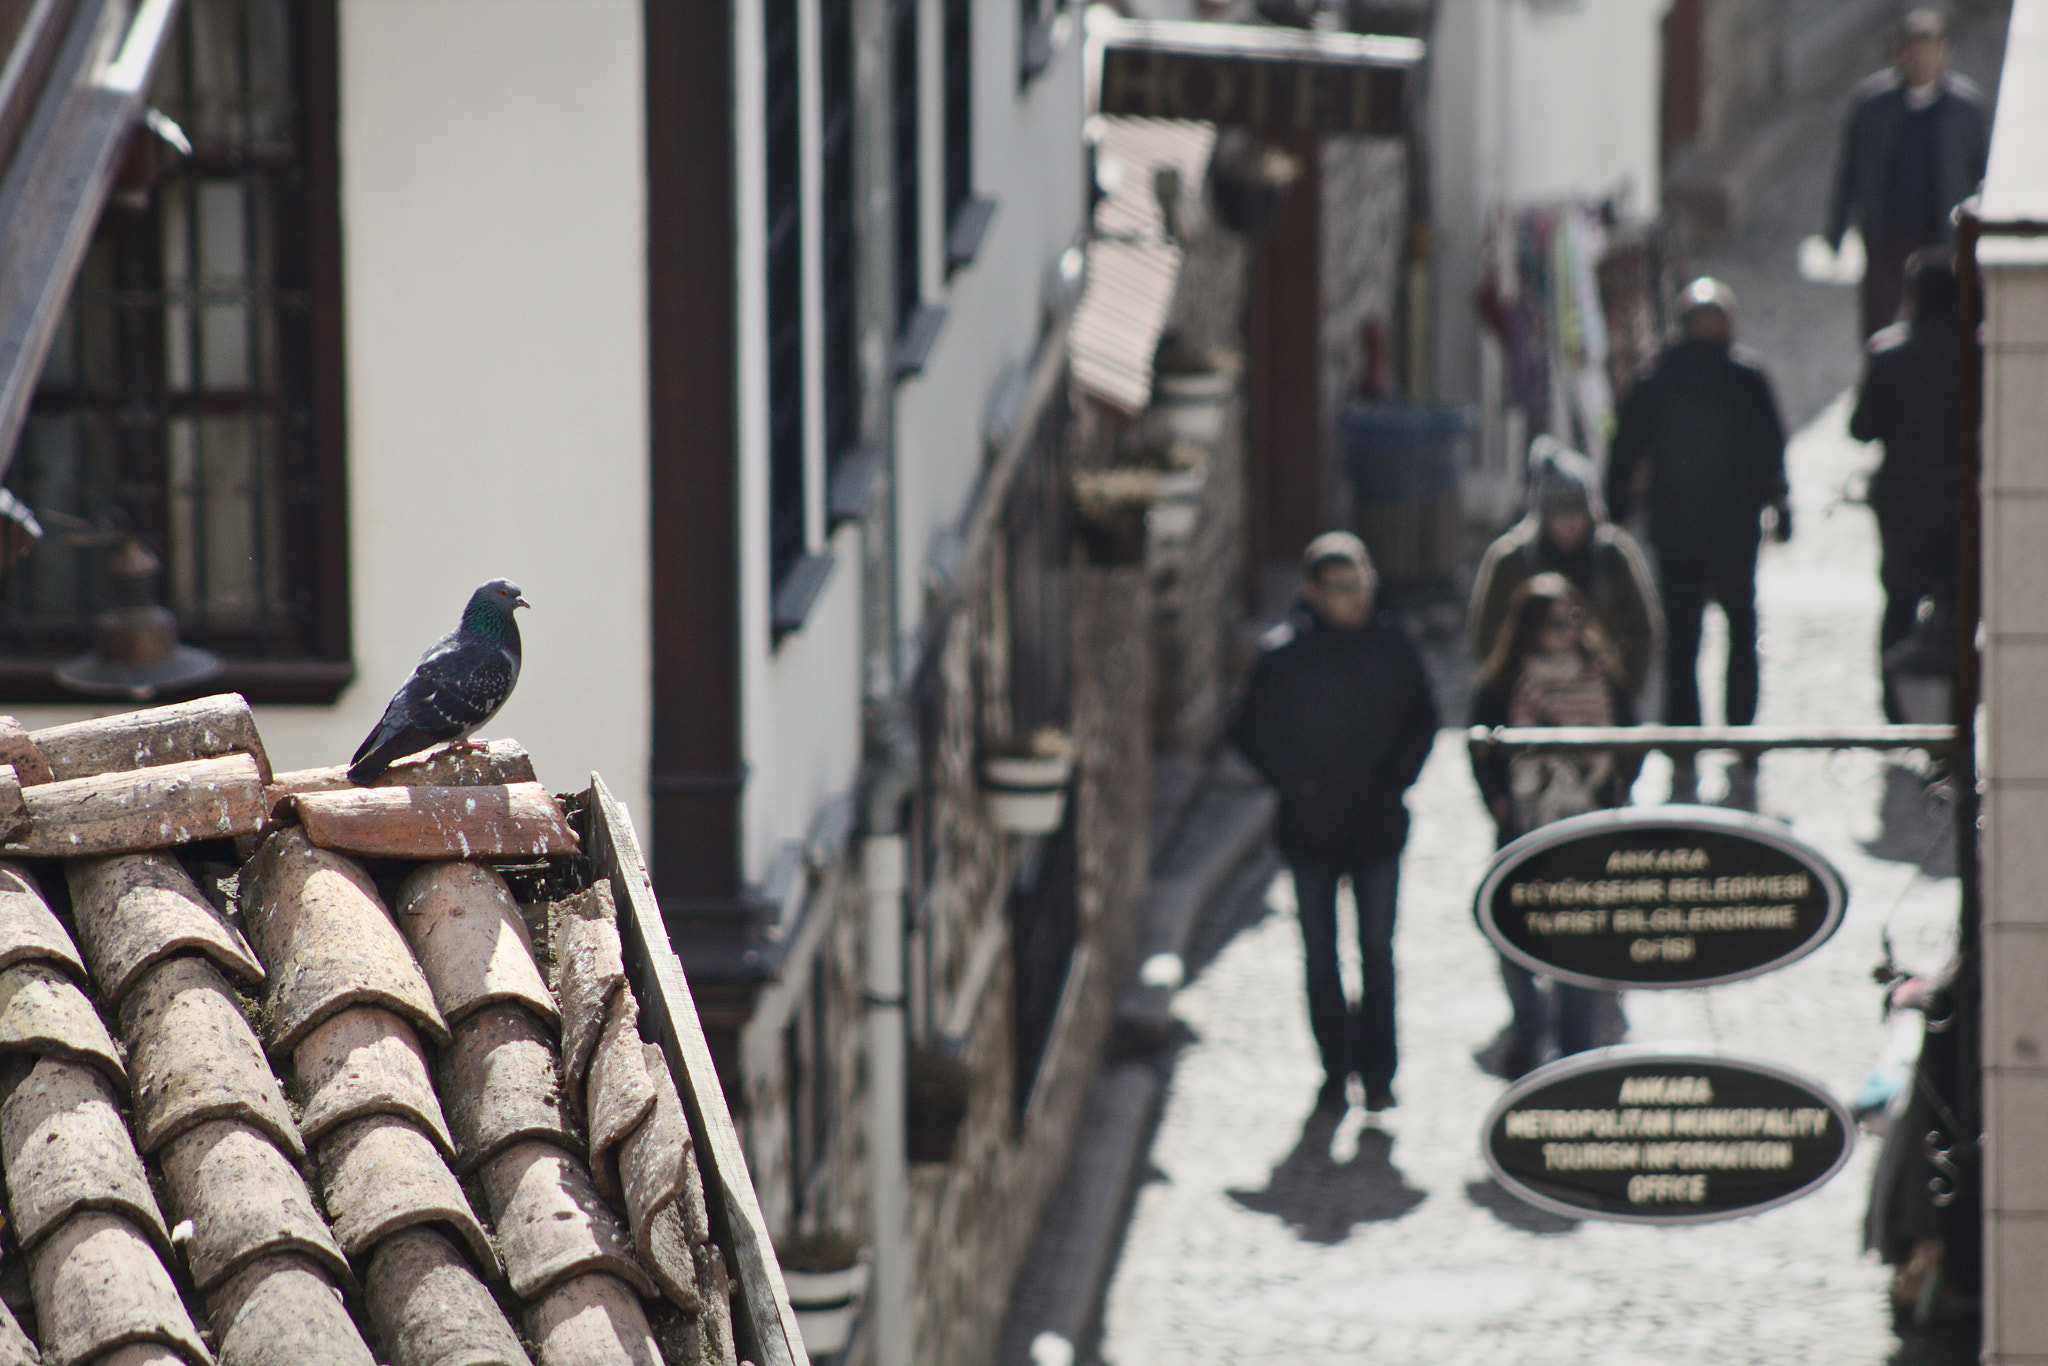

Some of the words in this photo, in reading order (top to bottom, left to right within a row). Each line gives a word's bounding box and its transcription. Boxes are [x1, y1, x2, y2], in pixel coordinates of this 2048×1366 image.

[1607, 849, 1709, 873] ANKARA
[1619, 1076, 1713, 1105] ANKARA
[1506, 1109, 1671, 1138] METROPOLITAN
[1674, 1108, 1828, 1137] MUNICIPALITY
[1543, 1142, 1639, 1170] TOURISM
[1641, 1141, 1792, 1169] INFORMATION
[1628, 1174, 1707, 1203] OFFICE
